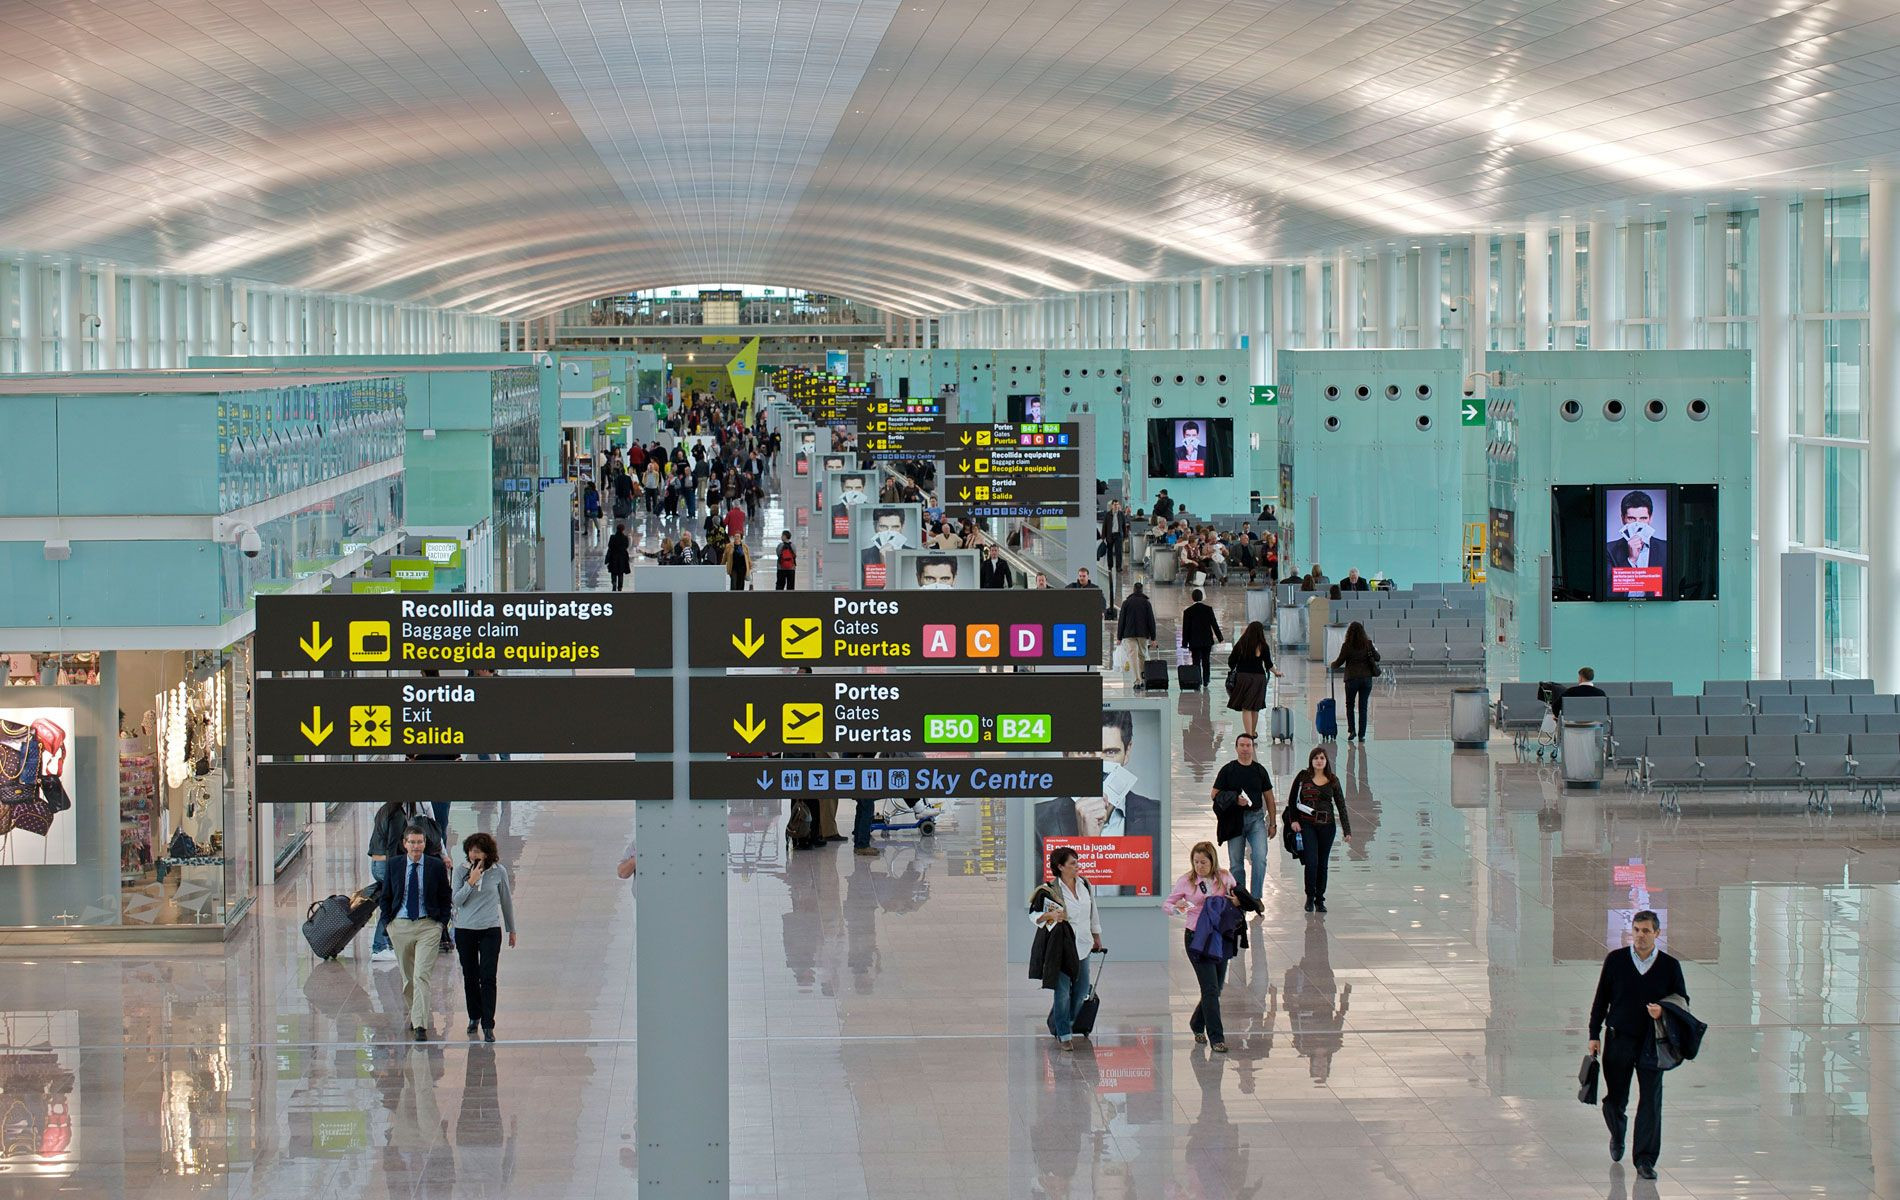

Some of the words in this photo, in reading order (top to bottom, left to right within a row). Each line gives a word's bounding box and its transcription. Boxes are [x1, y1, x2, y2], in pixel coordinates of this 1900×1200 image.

[1018, 508, 1033, 516] Sky
[402, 600, 494, 617] Recollida
[503, 600, 612, 620] equipatges
[835, 598, 898, 614] Portes
[403, 623, 471, 640] Baggage
[478, 622, 518, 637] claim
[834, 620, 878, 634] Gates
[835, 640, 910, 656] Puertas
[931, 630, 948, 651] A
[974, 630, 991, 652] C
[1019, 630, 1035, 651] D
[1063, 630, 1076, 651] E
[403, 642, 495, 662] Recogida
[504, 642, 599, 662] equipajes
[403, 685, 474, 702] Sortida
[836, 683, 899, 700] Portes
[403, 707, 431, 722] Exit
[835, 705, 879, 720] Gates
[836, 725, 911, 741] Puertas
[931, 719, 973, 738] B50
[984, 731, 991, 740] a
[1003, 719, 1045, 738] B24
[982, 717, 993, 727] to
[403, 727, 463, 744] Salida
[915, 769, 960, 794] Sky
[971, 768, 1053, 789] Centre
[1092, 844, 1115, 853] jugada
